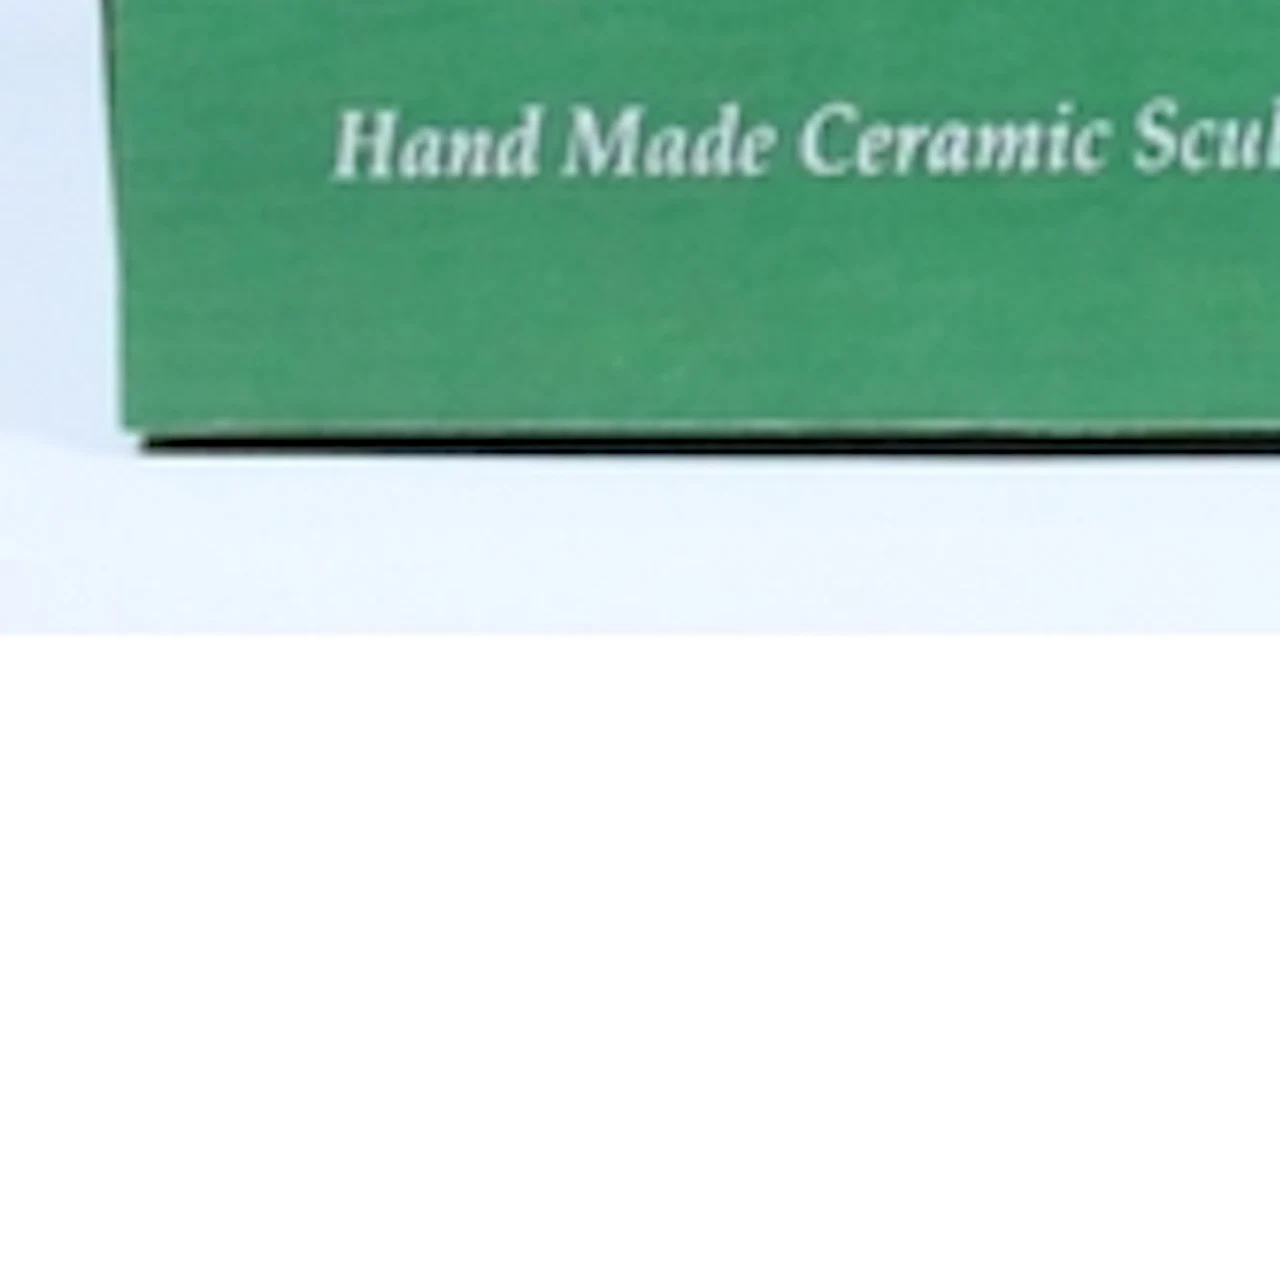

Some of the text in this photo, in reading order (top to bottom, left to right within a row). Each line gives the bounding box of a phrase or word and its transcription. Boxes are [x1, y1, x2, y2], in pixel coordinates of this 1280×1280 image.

[332, 103, 543, 181] Hand
[561, 102, 777, 178] Made
[800, 101, 1111, 177] Ceramic
